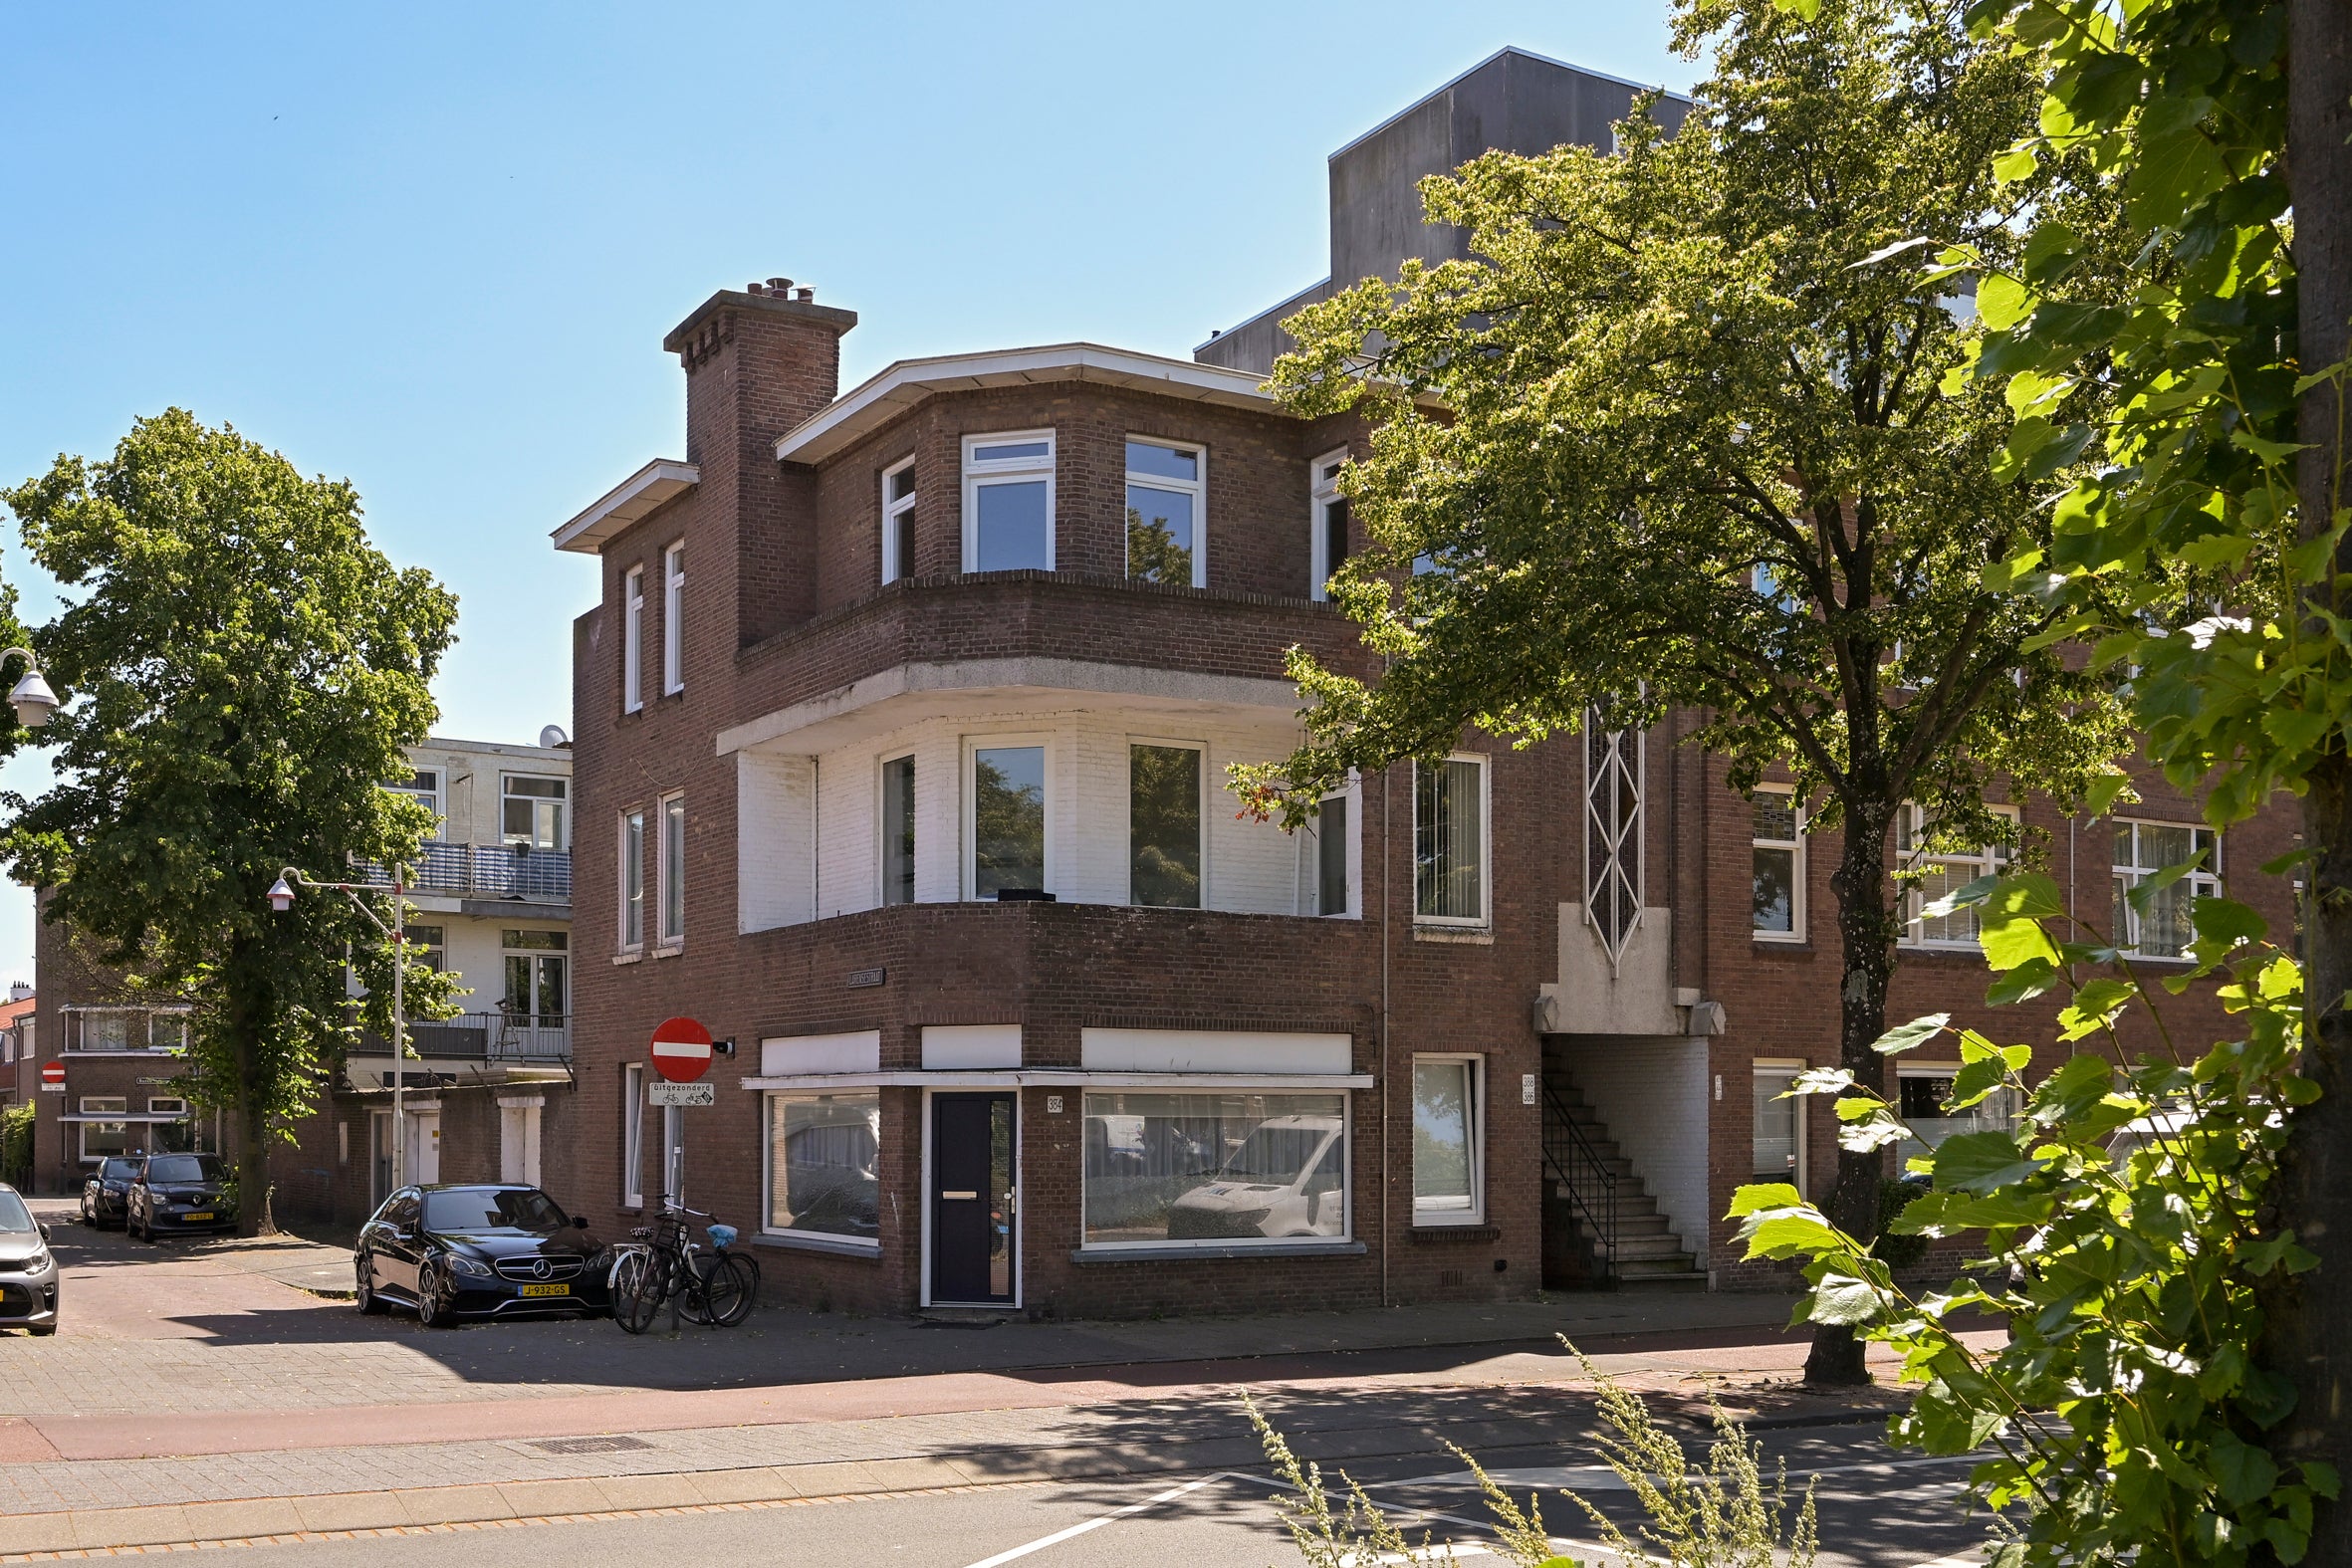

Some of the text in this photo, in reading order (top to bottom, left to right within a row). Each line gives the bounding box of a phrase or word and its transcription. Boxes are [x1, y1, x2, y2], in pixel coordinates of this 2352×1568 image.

[1524, 1076, 1533, 1087] 388
[1524, 1091, 1533, 1102] 386
[1049, 1098, 1062, 1110] 384
